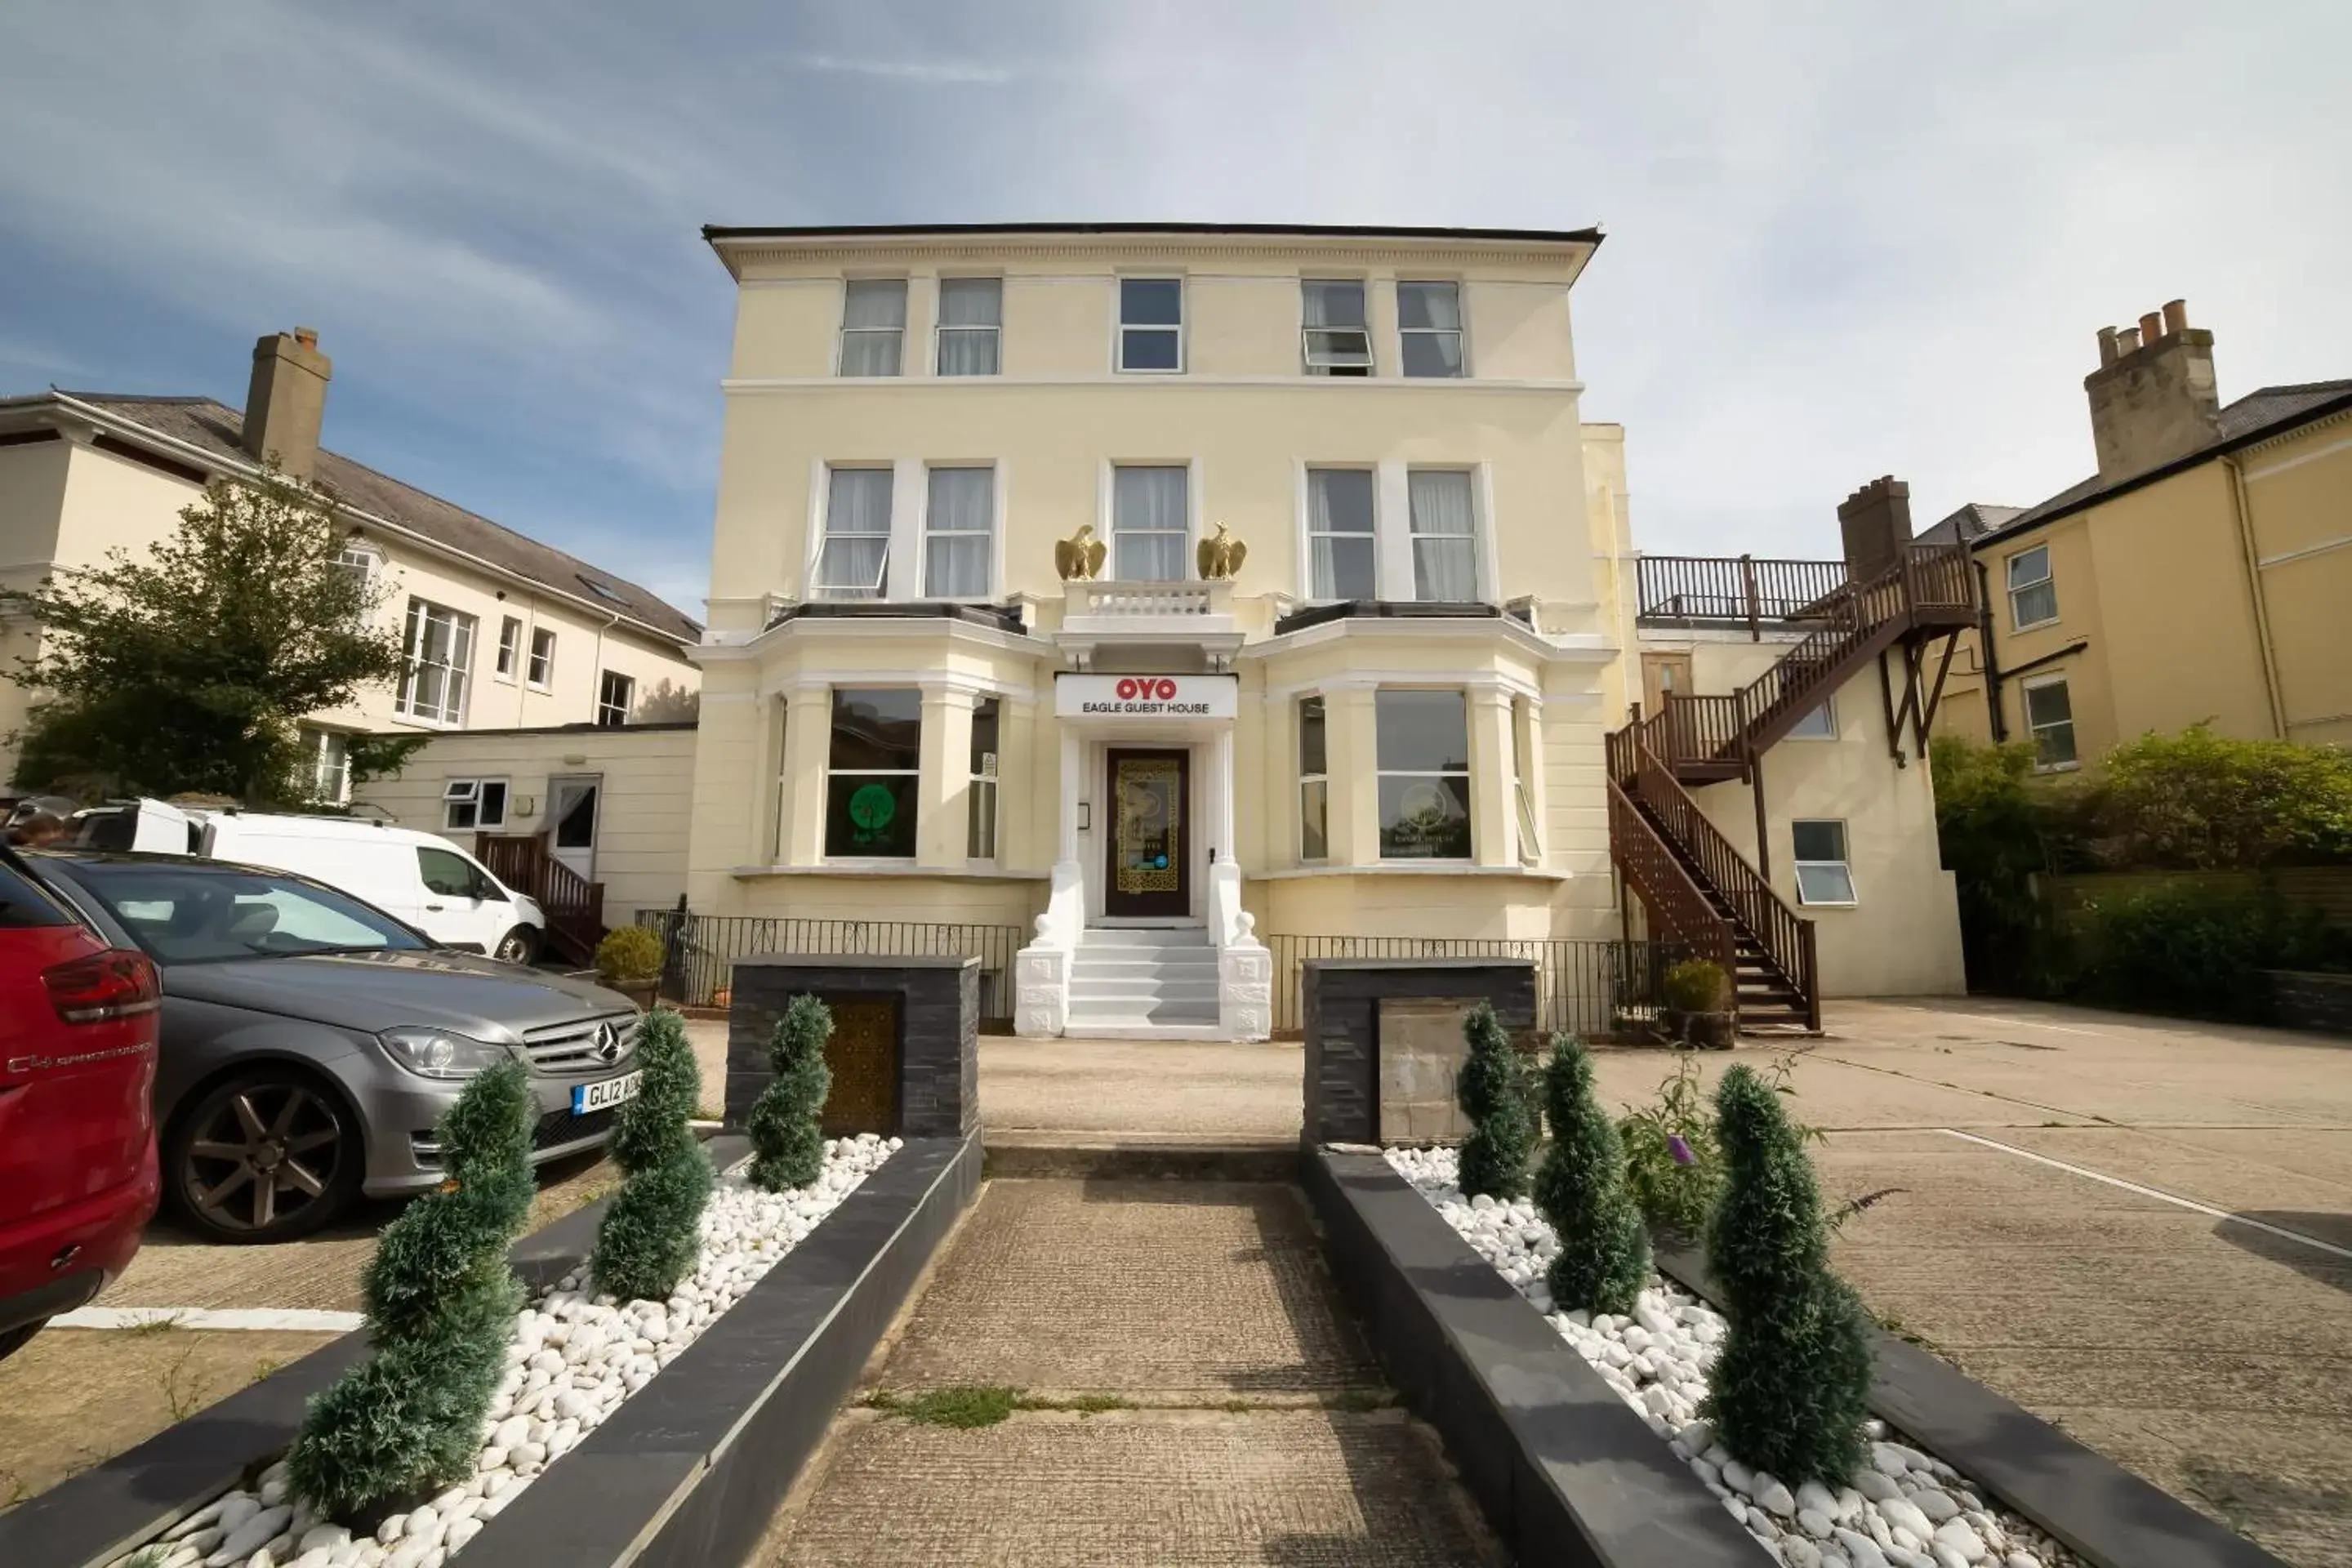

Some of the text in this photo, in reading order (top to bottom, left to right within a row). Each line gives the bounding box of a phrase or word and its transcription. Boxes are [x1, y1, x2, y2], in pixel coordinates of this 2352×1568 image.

[1116, 679, 1177, 700] OYO
[1083, 702, 1209, 714] EAGLE GUEST HOUSE
[589, 1081, 621, 1106] GL12
